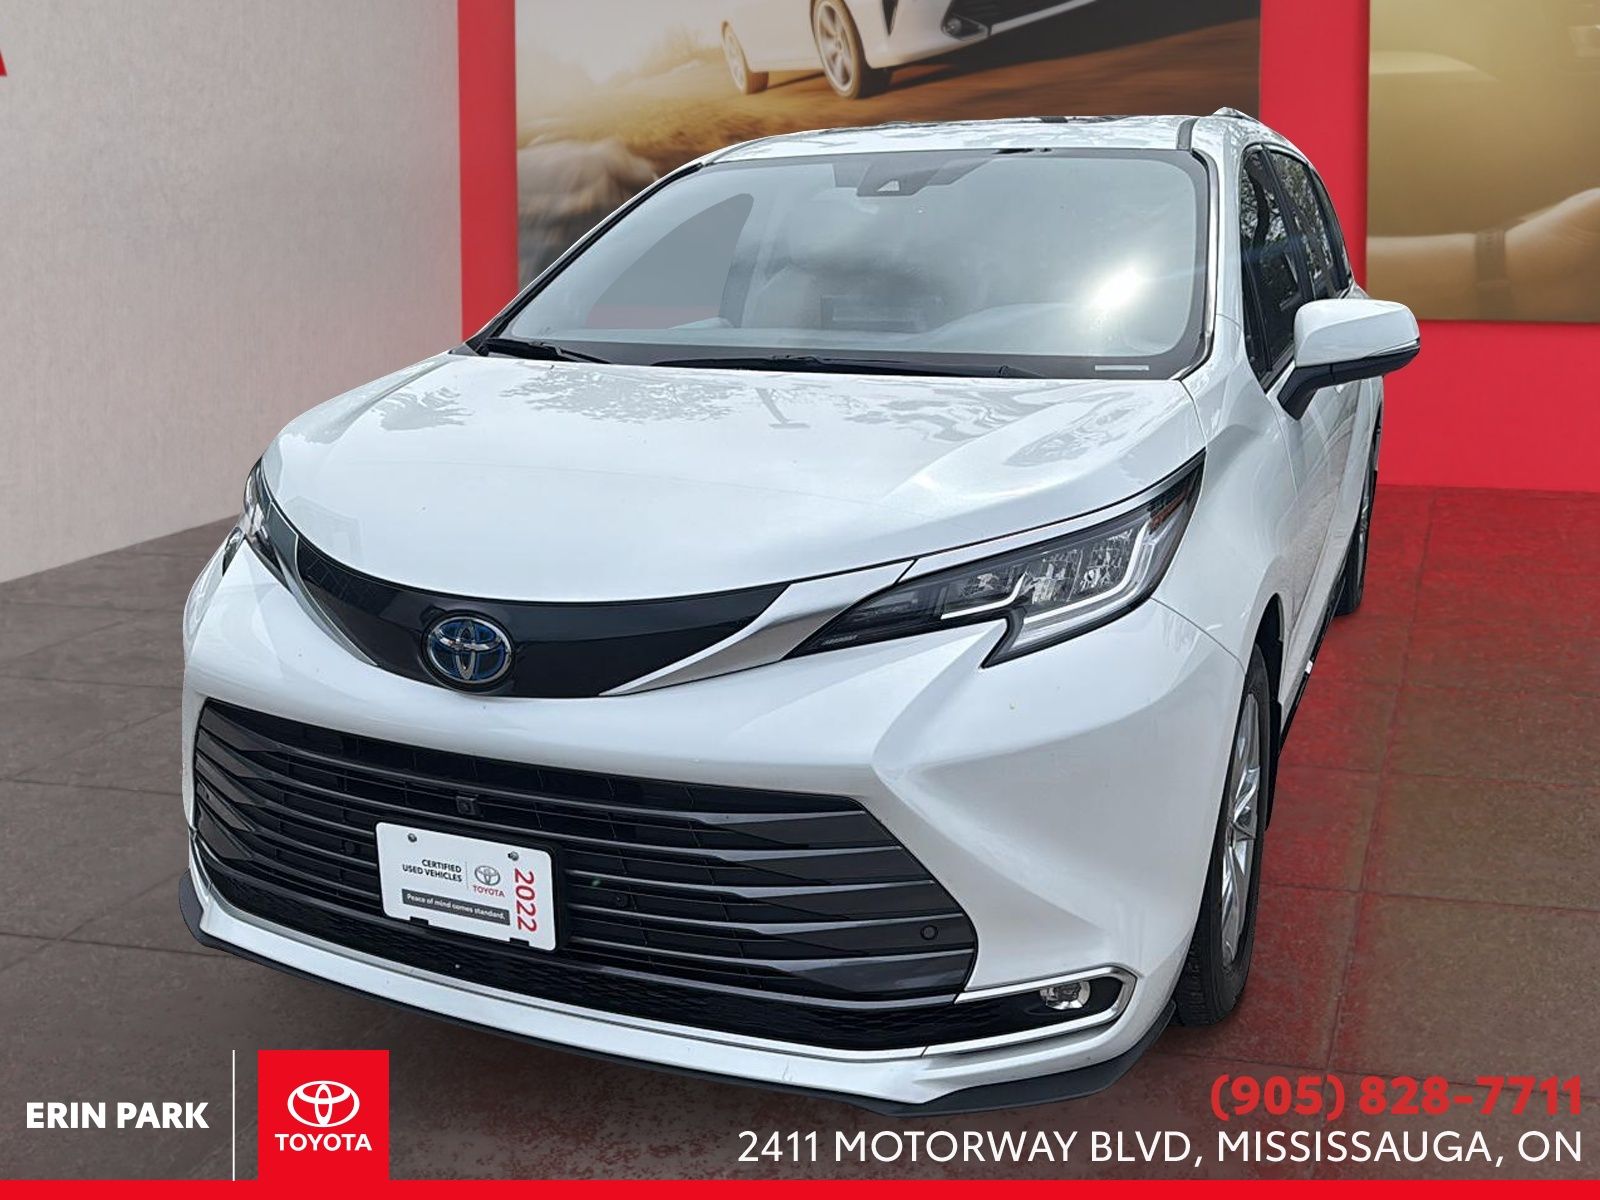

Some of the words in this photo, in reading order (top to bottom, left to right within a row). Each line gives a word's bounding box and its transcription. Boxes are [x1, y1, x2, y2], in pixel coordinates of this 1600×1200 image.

[402, 863, 424, 875] USED
[425, 867, 462, 883] VEHICLES
[421, 859, 462, 873] CERTIFIED
[472, 884, 506, 898] TOYOTA
[514, 867, 538, 932] 2022
[406, 892, 426, 904] Peace
[427, 896, 434, 905] of
[434, 898, 451, 909] mind
[452, 903, 474, 914] comes
[475, 907, 506, 920] standard.
